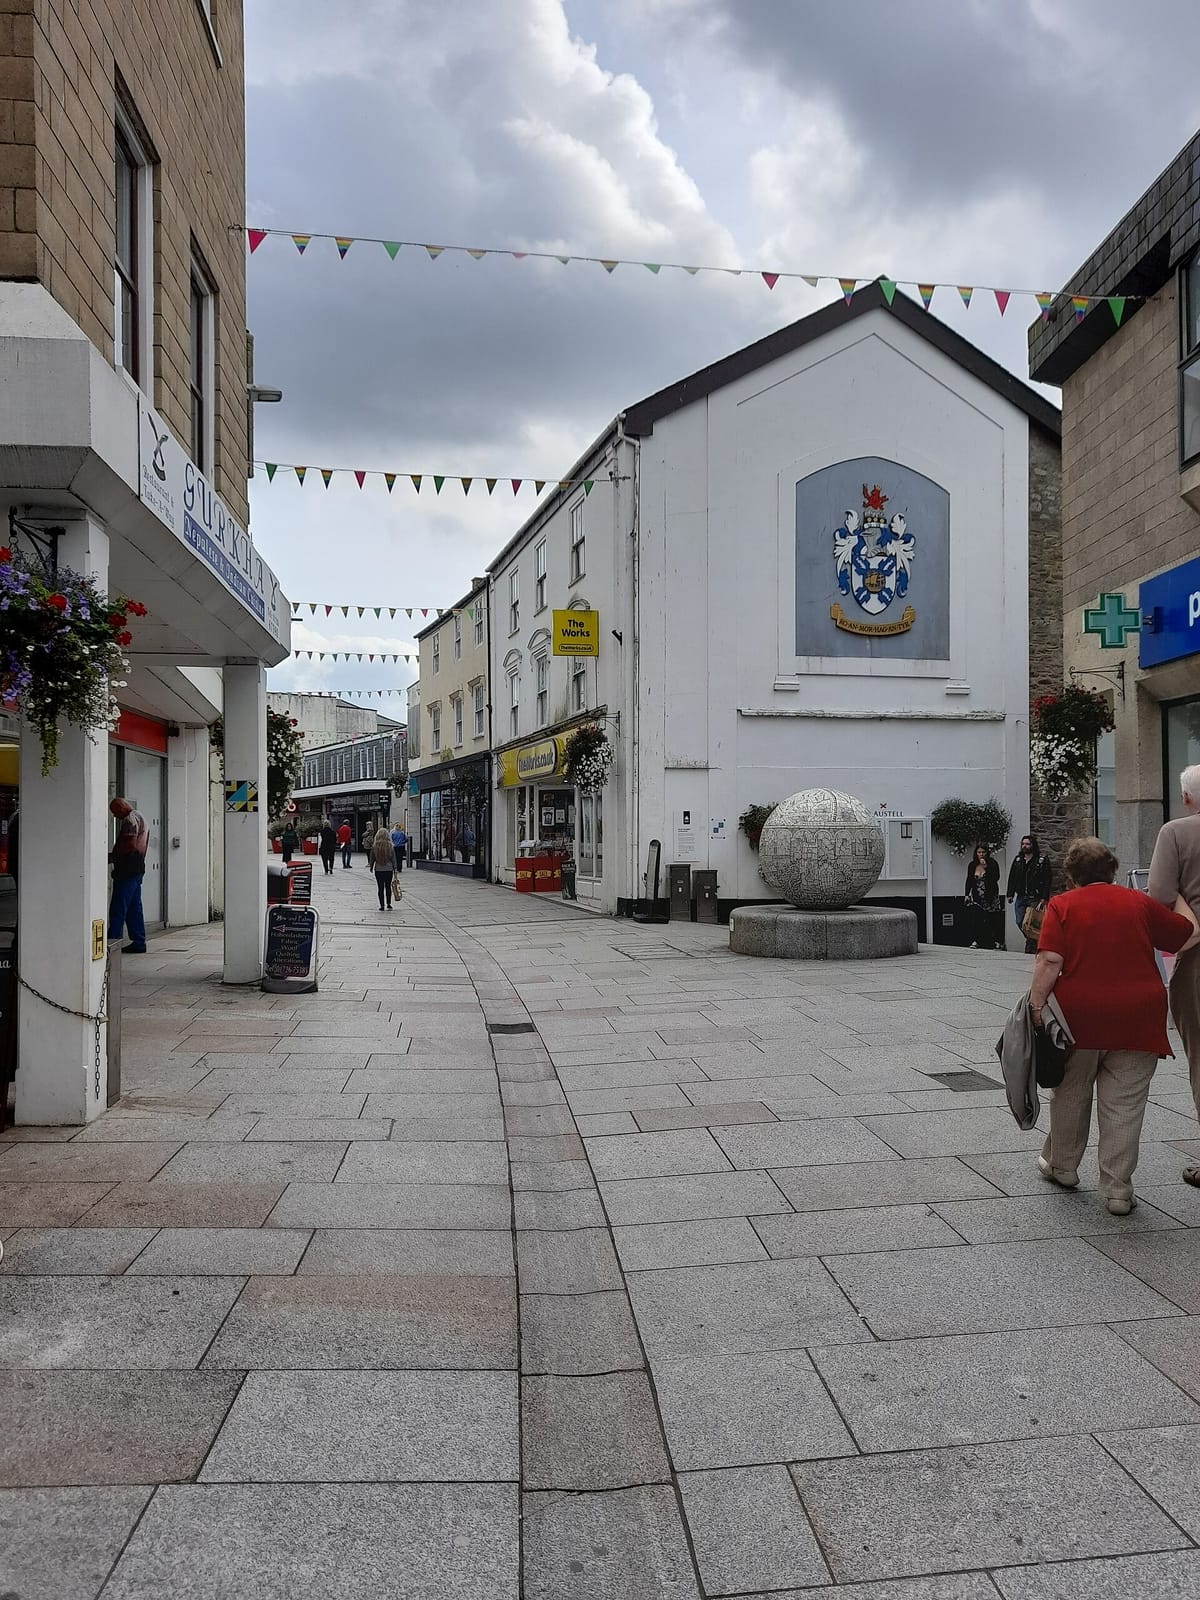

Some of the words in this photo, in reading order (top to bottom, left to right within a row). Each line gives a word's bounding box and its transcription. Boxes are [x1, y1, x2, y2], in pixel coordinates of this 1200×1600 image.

[183, 463, 264, 595] GURKHA
[184, 515, 219, 566] Nepalese
[561, 628, 591, 638] Works
[568, 619, 585, 628] The
